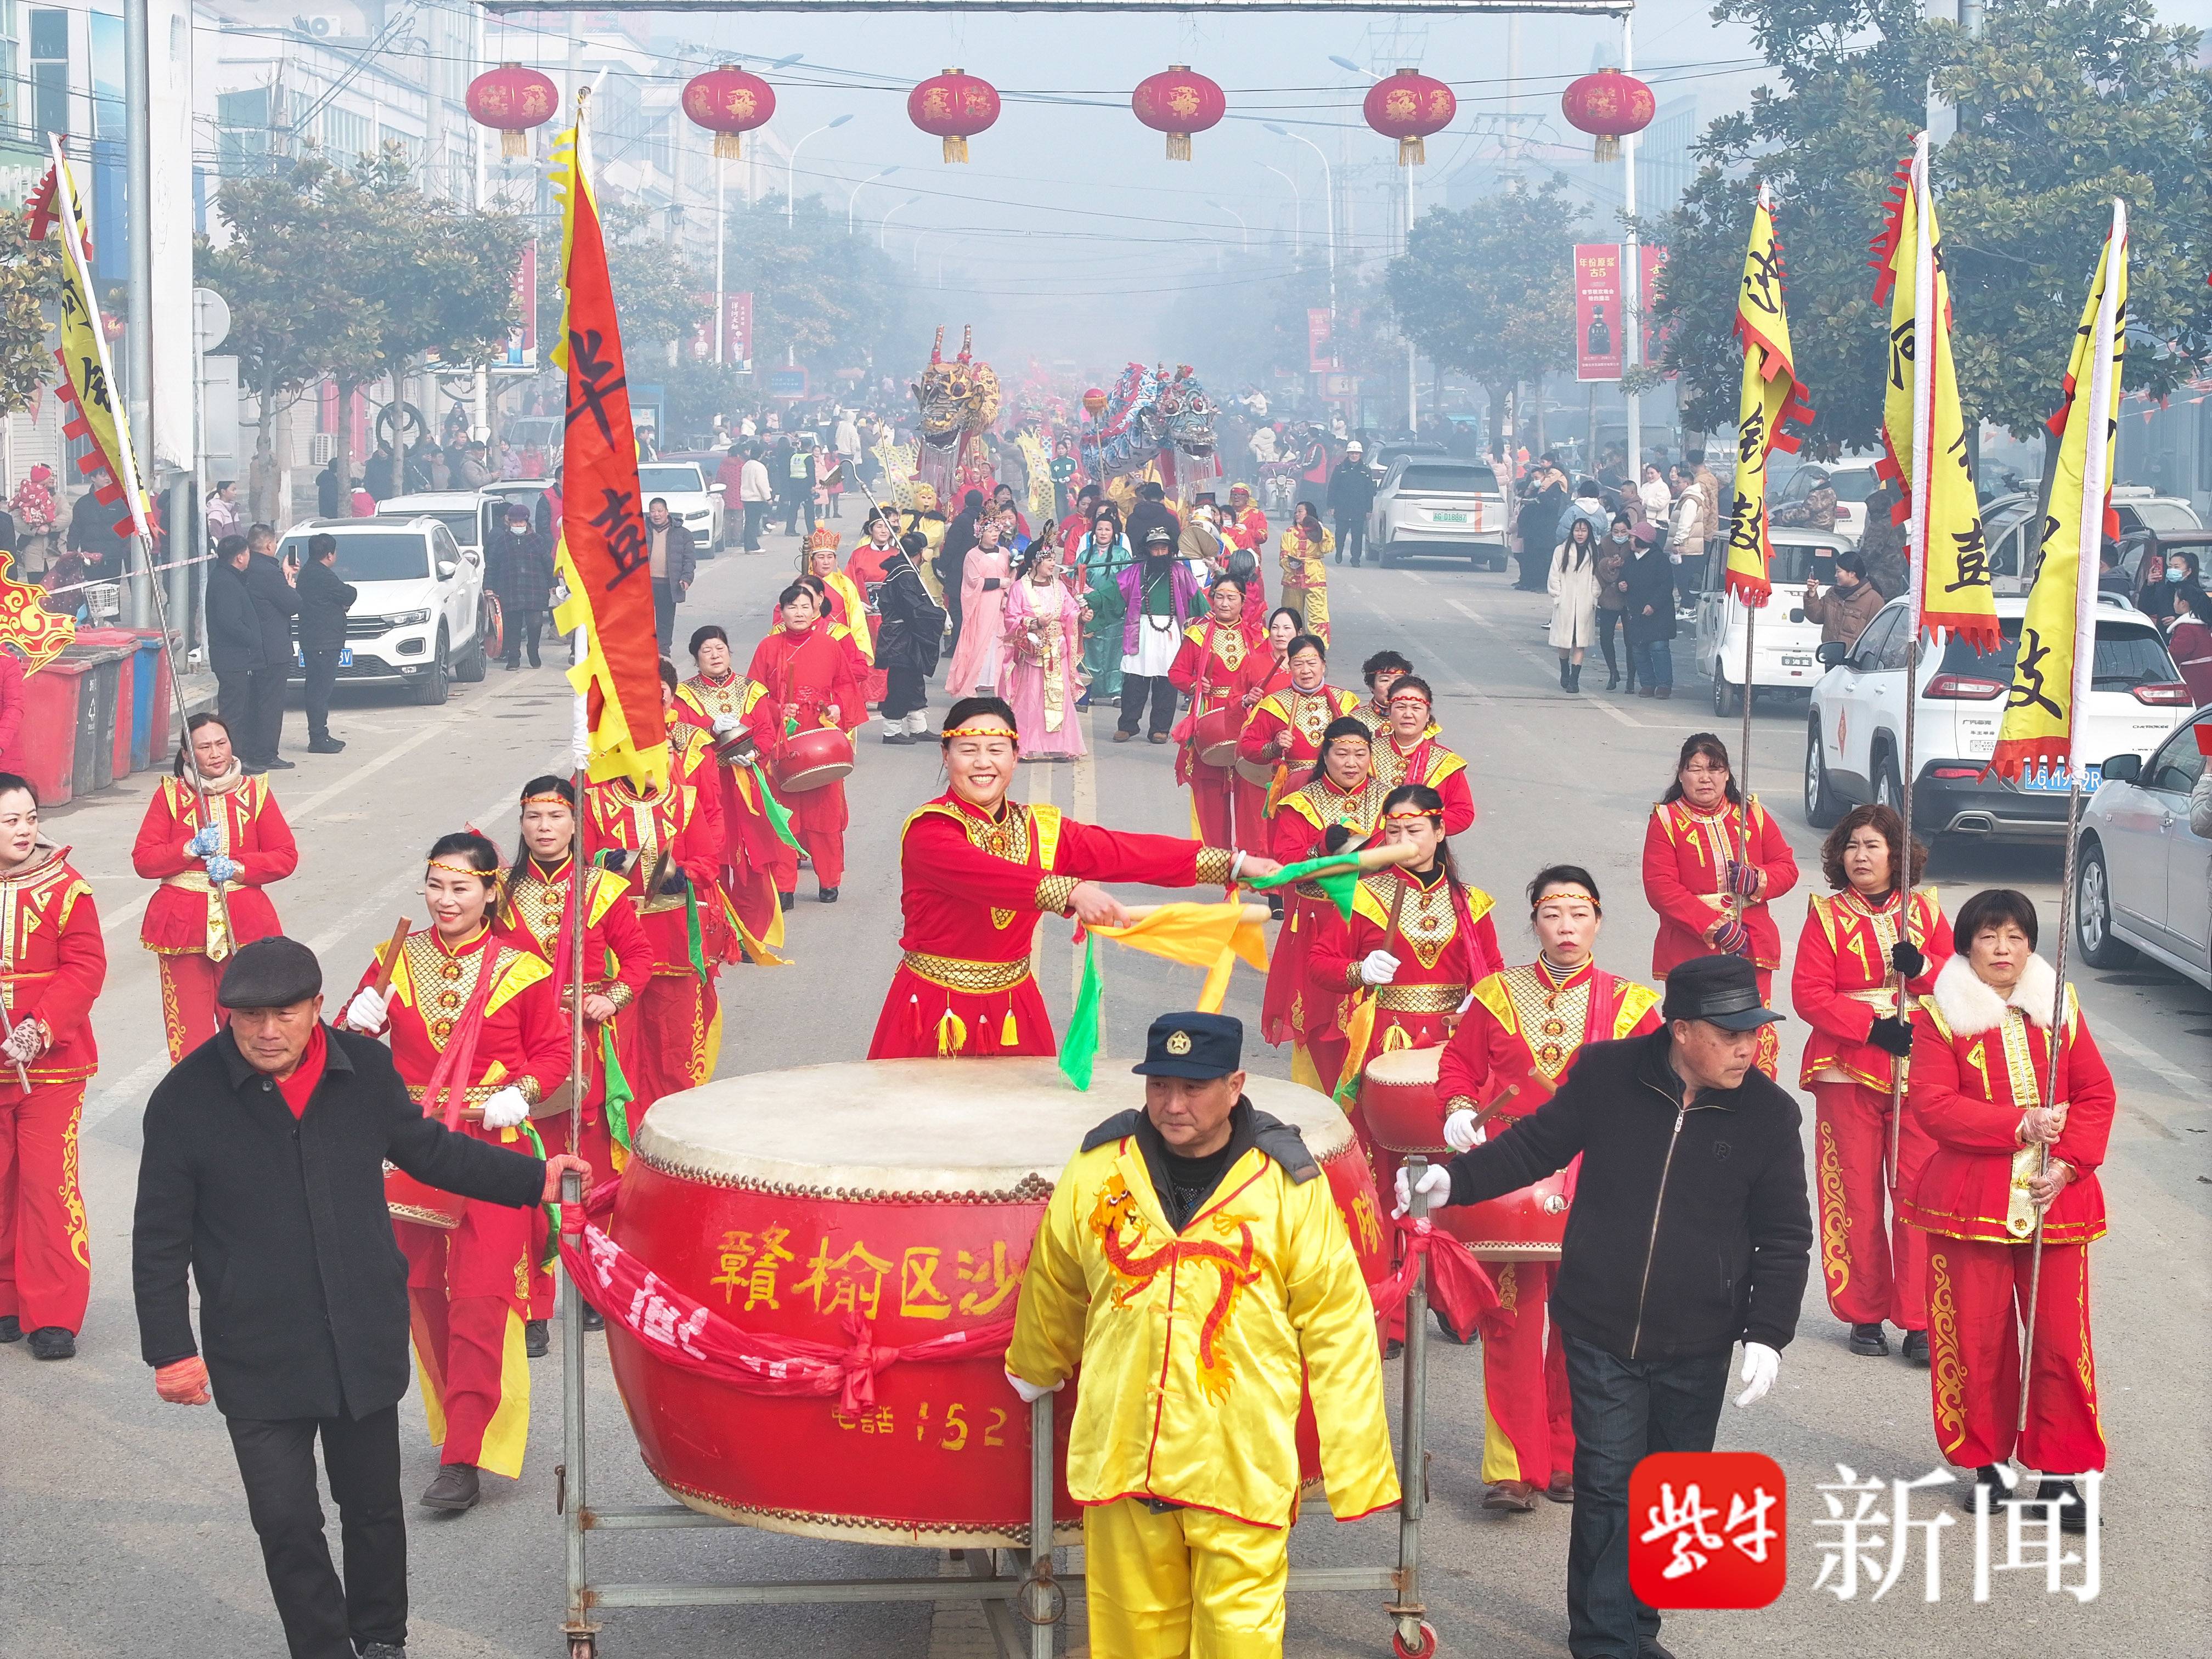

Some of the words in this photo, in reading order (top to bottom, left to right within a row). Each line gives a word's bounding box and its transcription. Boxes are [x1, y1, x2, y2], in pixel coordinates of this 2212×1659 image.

[1579, 257, 1615, 267] 年份原浆
[1589, 268, 1606, 277] 古5
